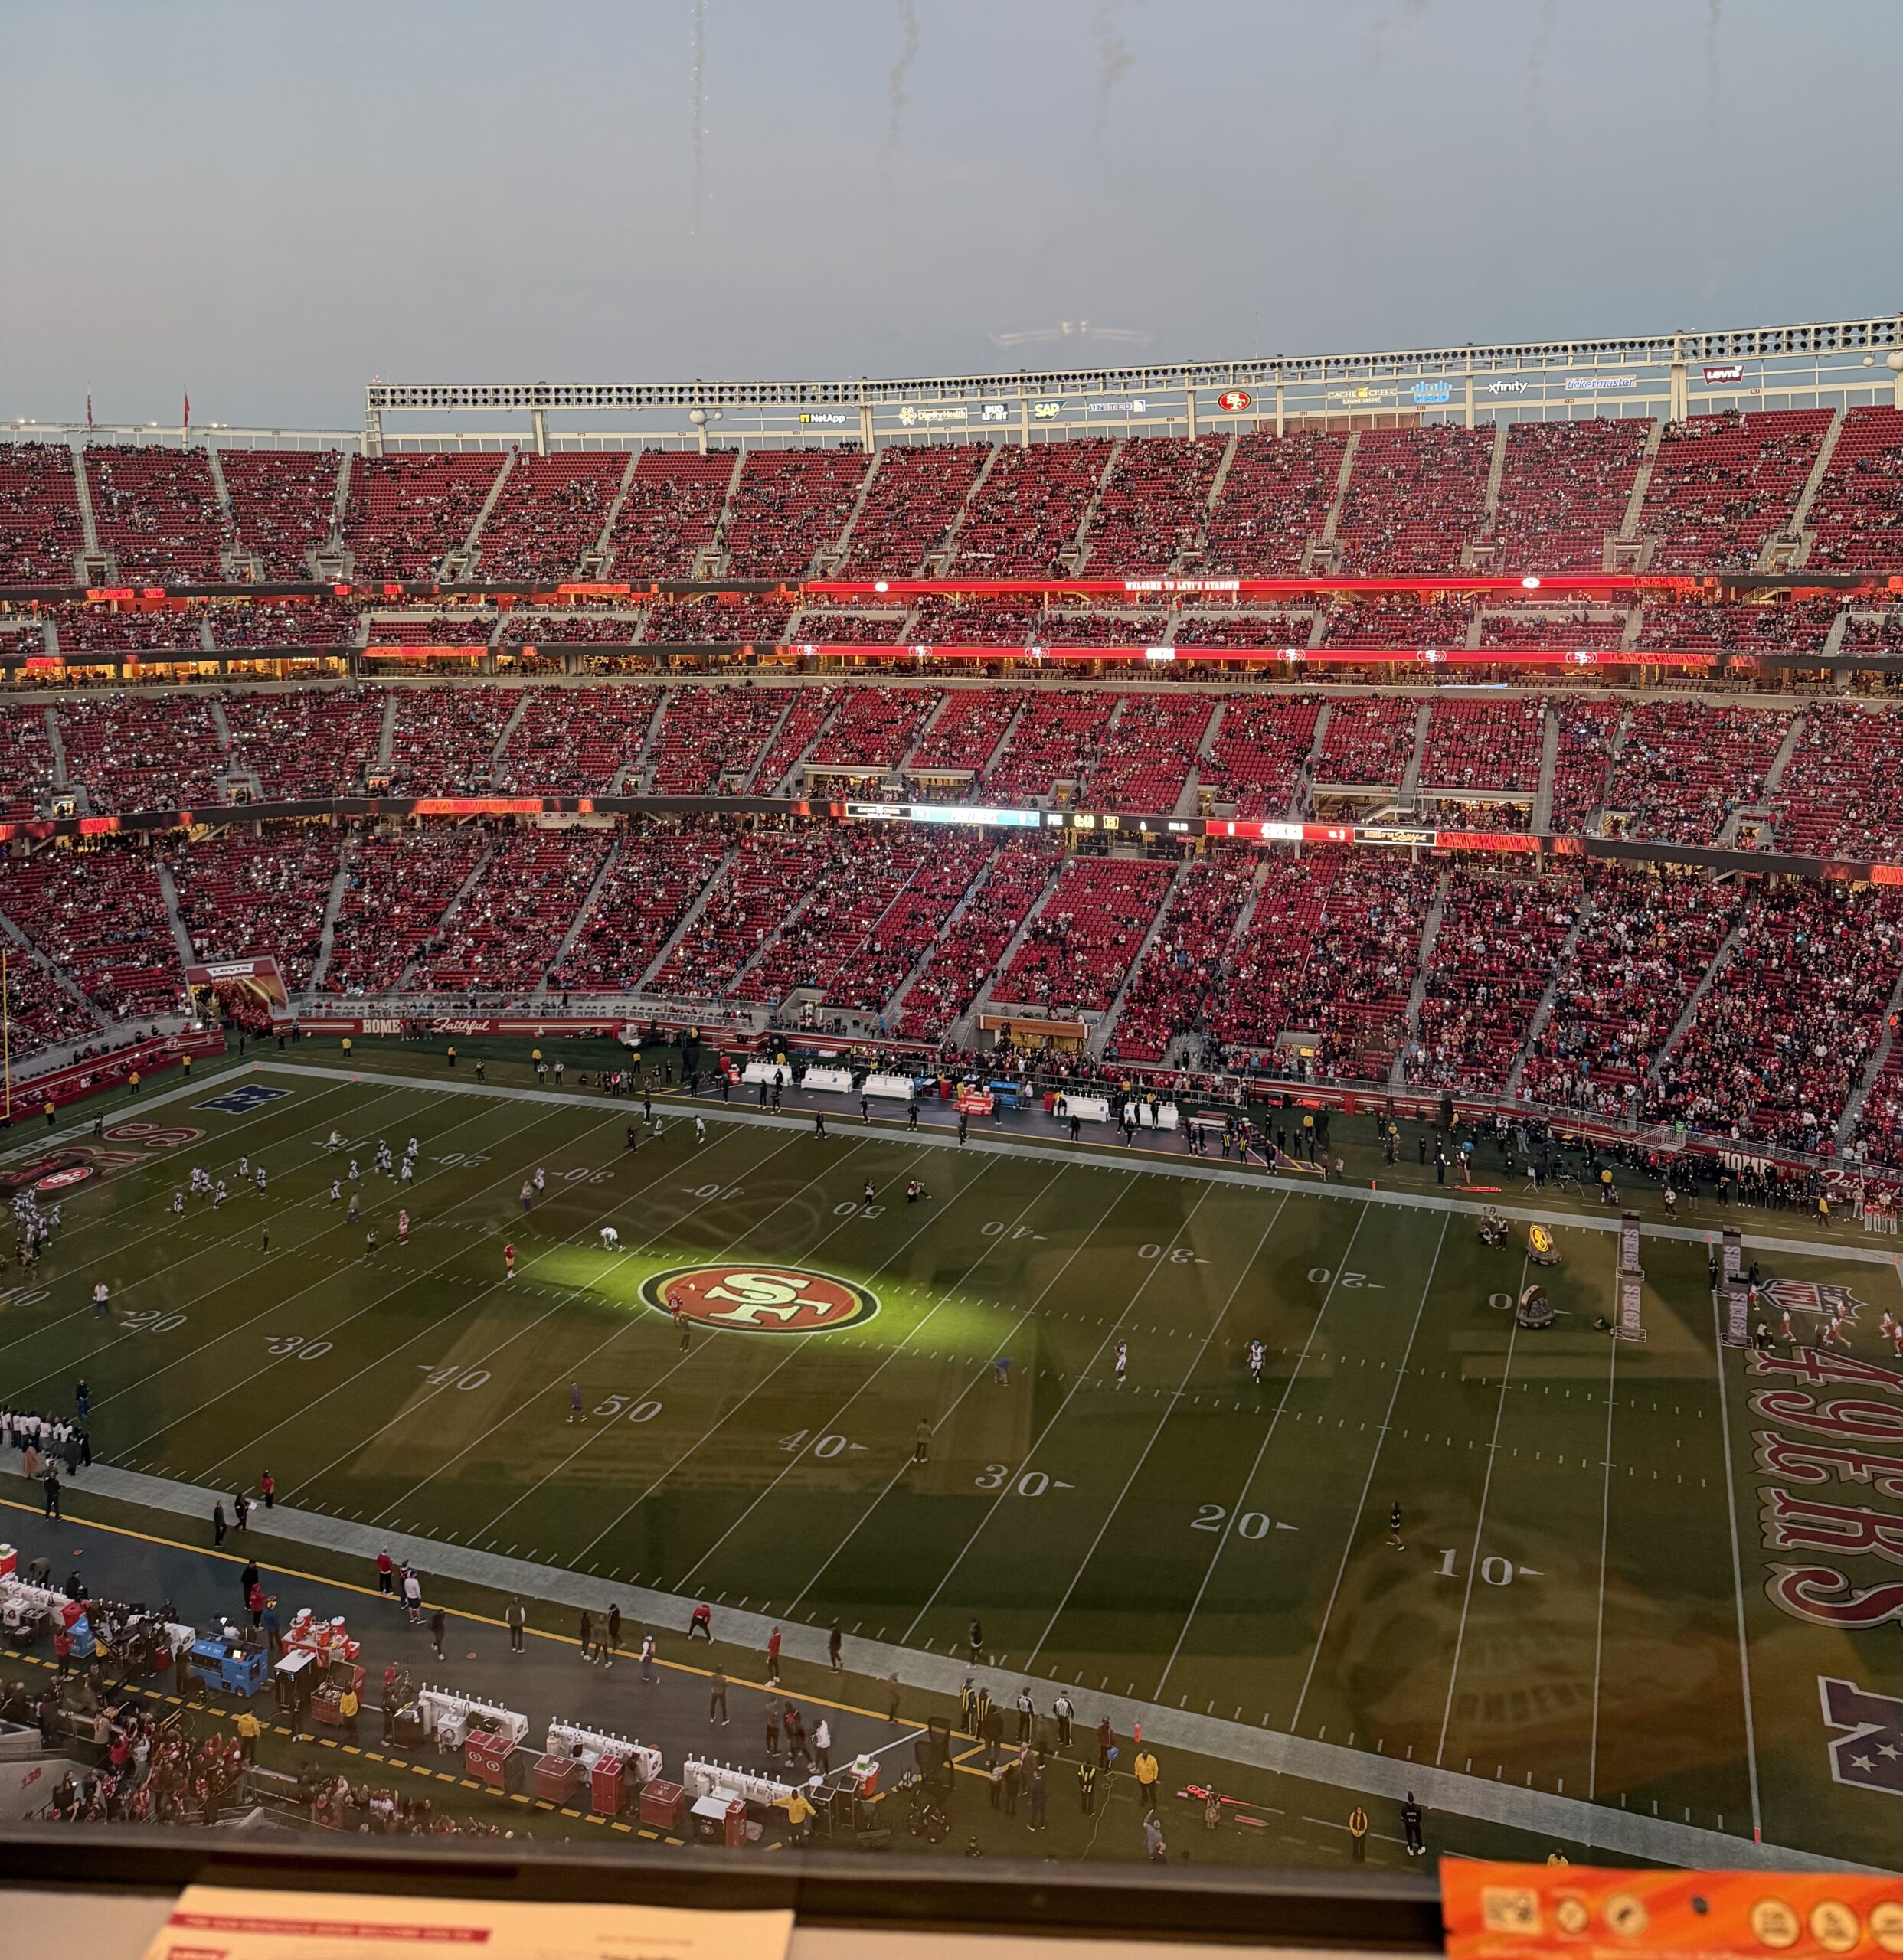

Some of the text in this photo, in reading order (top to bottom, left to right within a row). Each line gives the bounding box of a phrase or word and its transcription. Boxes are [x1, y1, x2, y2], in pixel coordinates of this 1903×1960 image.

[1328, 388, 1395, 399] CACHE CREEK
[1489, 380, 1528, 394] xfinity
[1567, 377, 1633, 390] ticketmaster
[919, 409, 966, 421] Dignity Health
[983, 412, 1008, 420] LIGHT
[1035, 403, 1060, 417] SAP
[1089, 403, 1131, 411] UNITED
[810, 413, 846, 424] NetApp
[363, 1016, 489, 1036] HOME Faithful
[441, 1152, 492, 1168] 20
[1718, 1150, 1773, 1177] HOME
[561, 1167, 616, 1184] 30
[695, 1184, 745, 1201] 40
[832, 1201, 887, 1220] 50
[981, 1220, 1035, 1241] 40
[1137, 1243, 1196, 1264] 30
[1307, 1266, 1369, 1289] 20
[703, 1273, 833, 1324] SF
[120, 1310, 188, 1333] 20
[268, 1335, 334, 1361] 30
[423, 1364, 492, 1391] 40
[593, 1394, 662, 1423] 50
[777, 1429, 847, 1458] 40
[974, 1464, 1049, 1497] 30
[1190, 1504, 1271, 1540] 20
[1434, 1548, 1514, 1586] 10
[21, 1766, 42, 1789] 138
